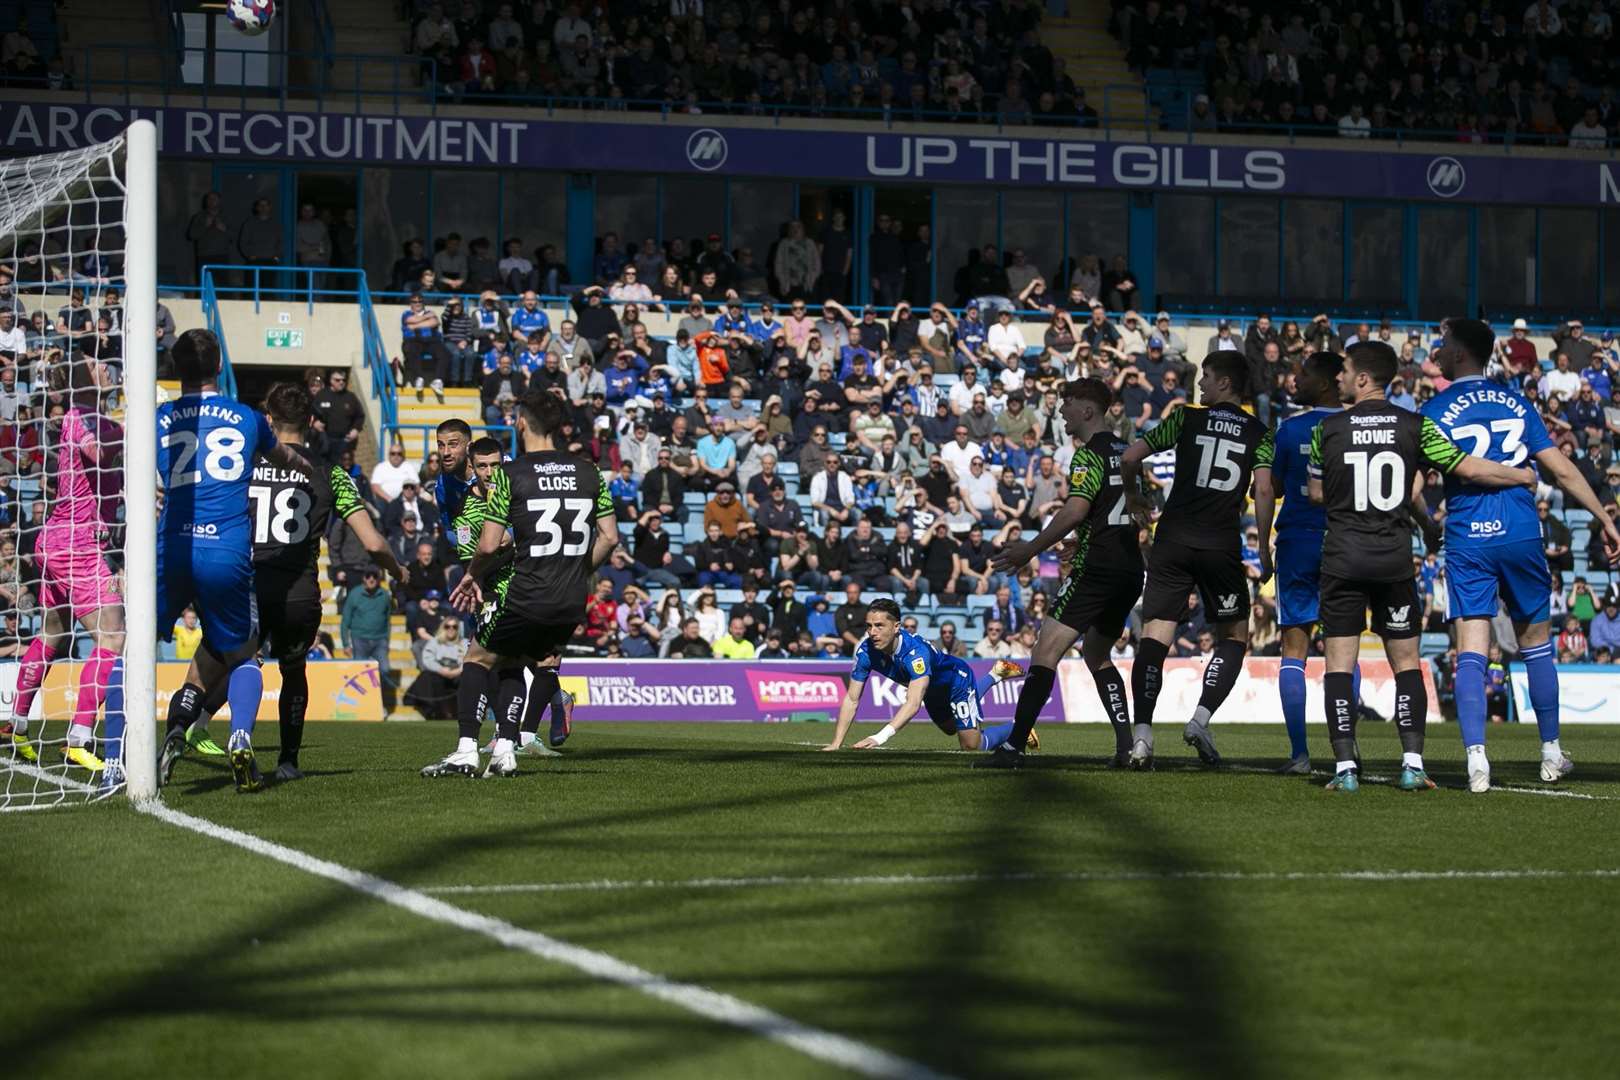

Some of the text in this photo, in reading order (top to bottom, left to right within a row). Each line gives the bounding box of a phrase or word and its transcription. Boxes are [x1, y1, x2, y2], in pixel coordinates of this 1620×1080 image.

[185, 111, 528, 163] RECRUITMENT
[867, 136, 1286, 190] UP THE GILLS
[159, 404, 243, 429] HAWKINS
[1440, 390, 1527, 426] MASTERSON
[1206, 419, 1242, 436] LONG
[1352, 429, 1396, 445] ROWE
[1450, 418, 1528, 467] 23
[161, 426, 246, 489] 28
[1195, 434, 1247, 492] 15
[538, 476, 577, 491] CLOSE
[1343, 450, 1405, 511] 10
[248, 486, 312, 544] 18
[526, 498, 594, 557] 33
[1470, 519, 1502, 533] PISO
[589, 677, 635, 686] MEDWAY
[1145, 665, 1158, 699] DRFC
[1205, 657, 1224, 687] DRFC
[591, 685, 737, 706] MESSENGER
[1106, 683, 1127, 723] DRFC
[1398, 694, 1412, 726] DRFC
[1335, 699, 1350, 731] DRFC
